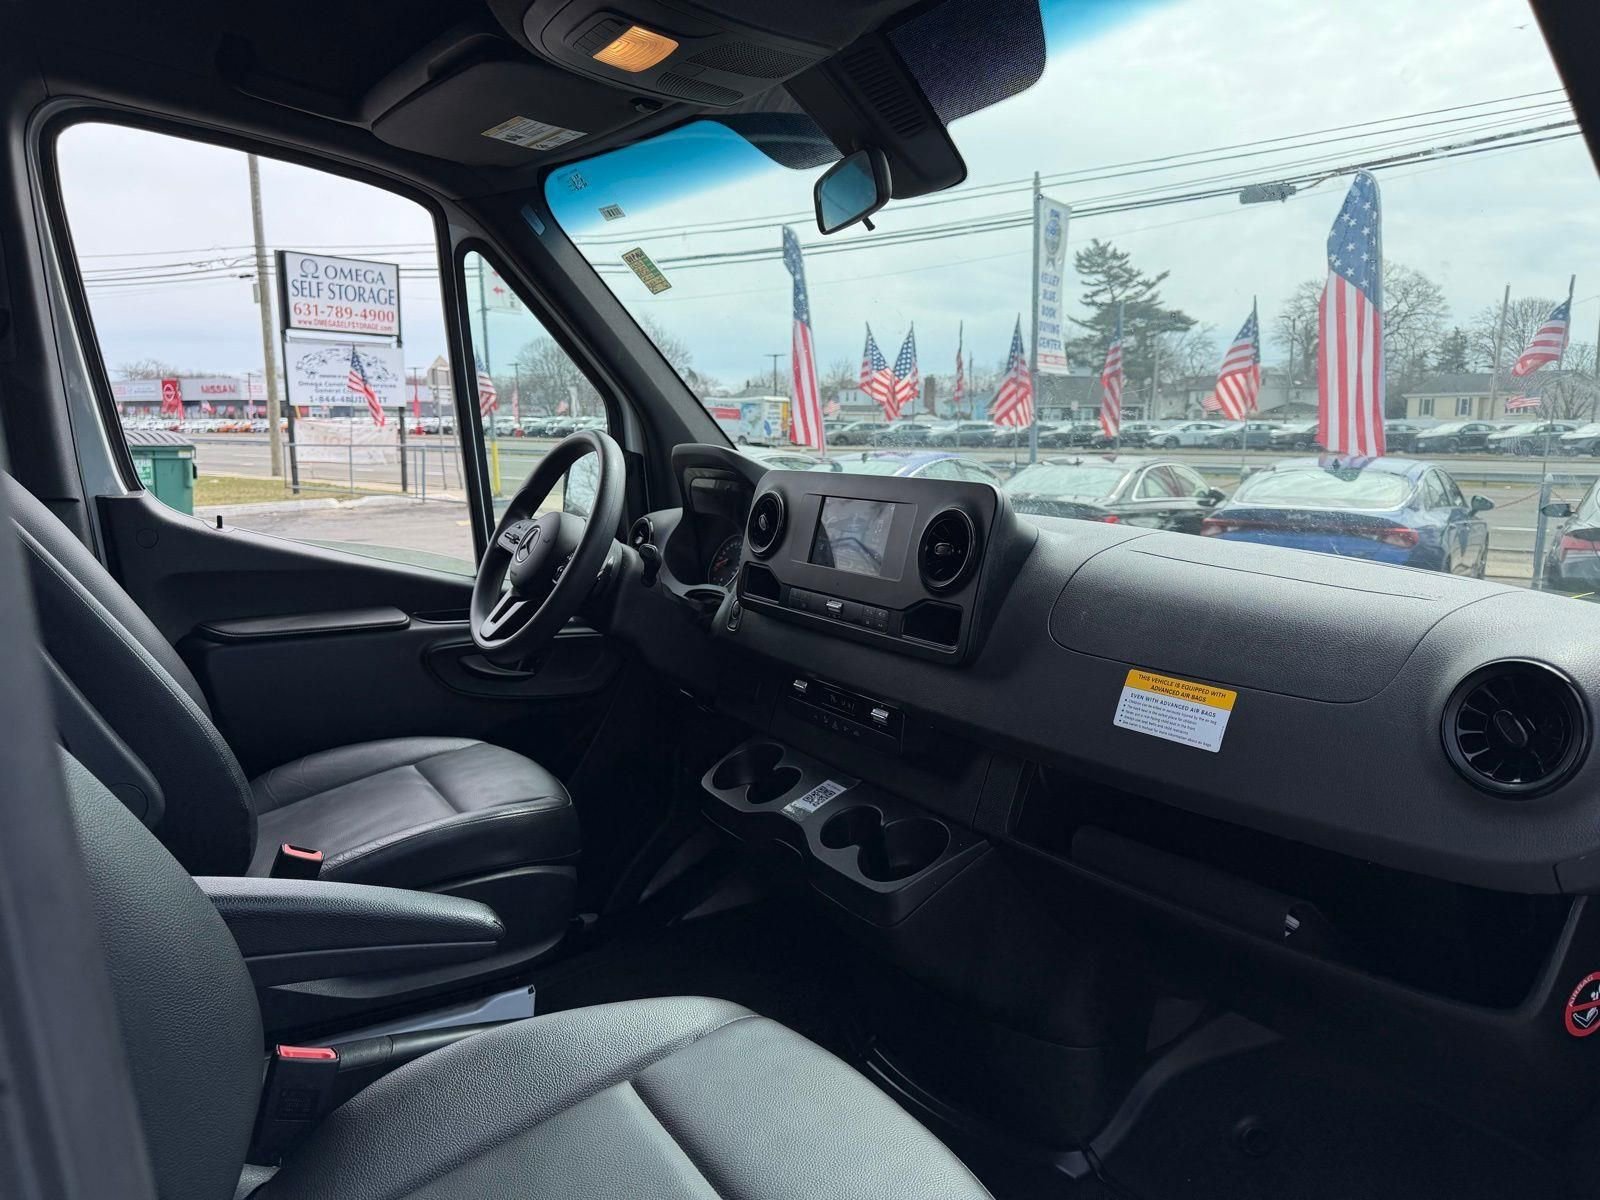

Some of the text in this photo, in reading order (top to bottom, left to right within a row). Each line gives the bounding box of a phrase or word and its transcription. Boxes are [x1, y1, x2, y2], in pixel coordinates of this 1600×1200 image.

[324, 264, 386, 285] OMEGA
[291, 279, 395, 306] SELF STORAGE
[293, 302, 395, 323] 631-789-4900
[201, 384, 236, 394] NISSAN
[1150, 685, 1180, 696] ADVANCED
[1190, 694, 1206, 702] BAGS
[1151, 677, 1174, 686] VEHICLE
[1180, 683, 1209, 694] EQUIPPED
[1210, 690, 1226, 698] WITH
[1130, 692, 1144, 700] EVEN
[1159, 699, 1189, 711] ADVANCED
[1200, 709, 1216, 717] BAGS
[1569, 974, 1594, 1007] AIRBAG
